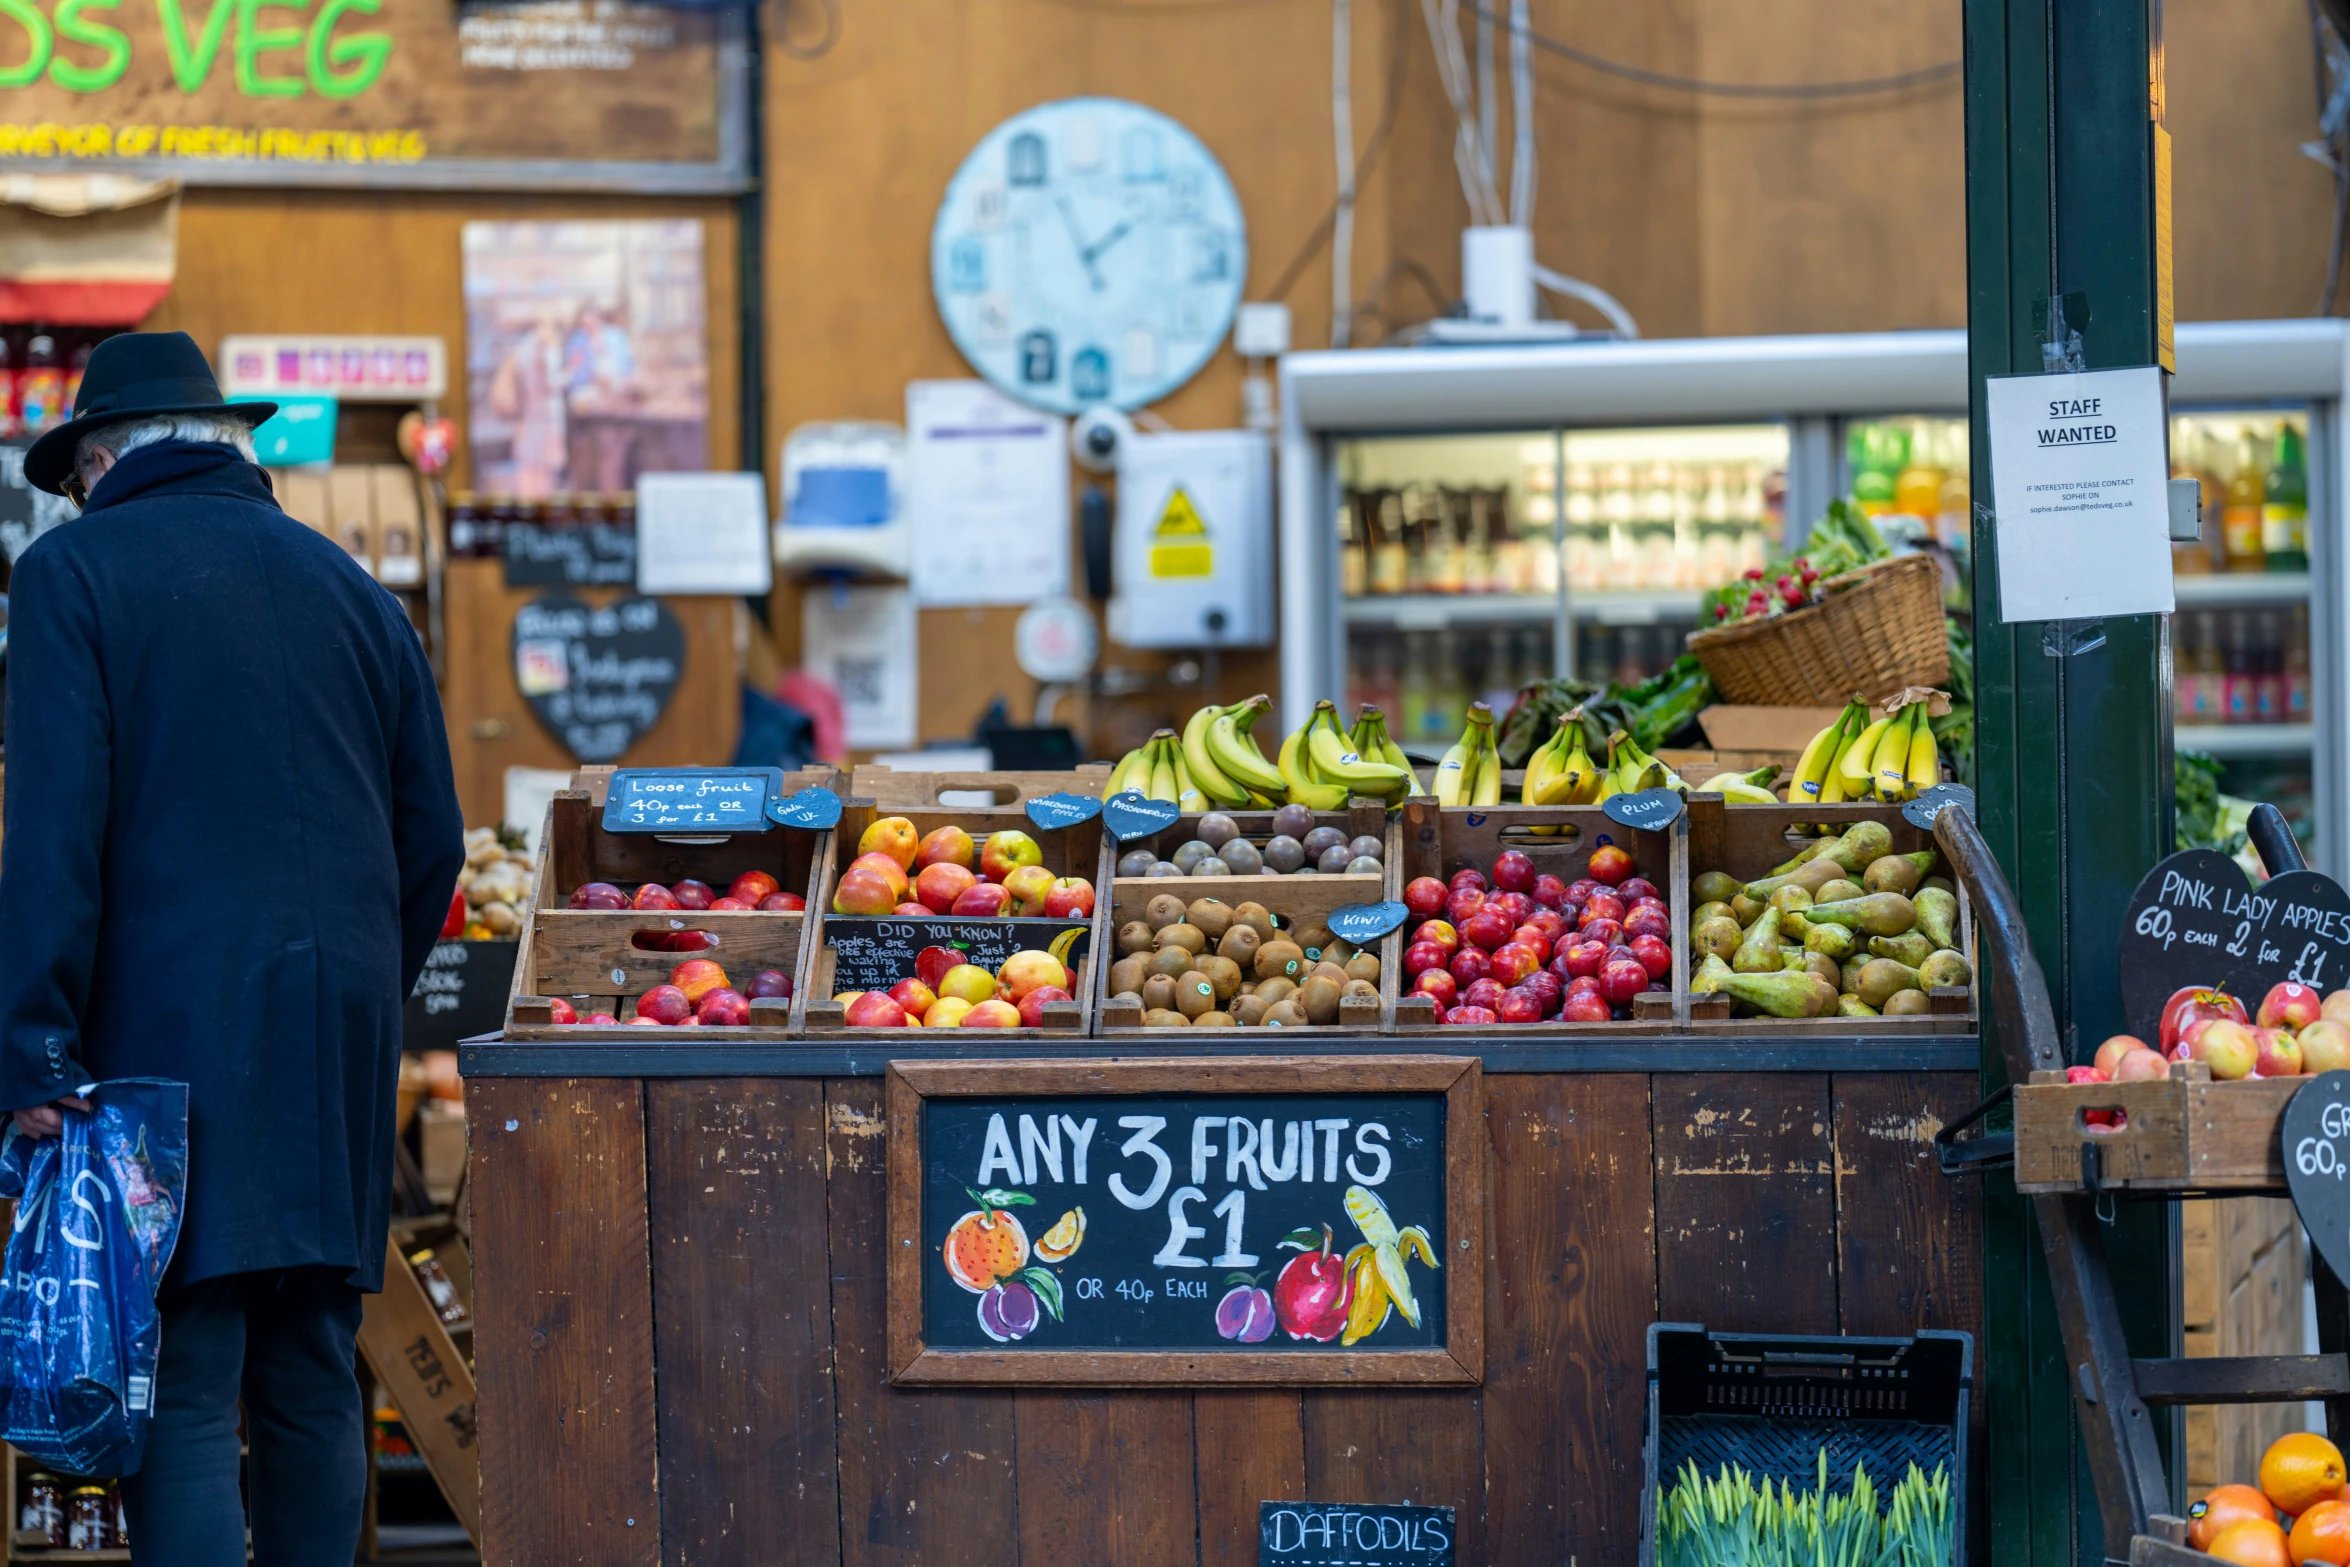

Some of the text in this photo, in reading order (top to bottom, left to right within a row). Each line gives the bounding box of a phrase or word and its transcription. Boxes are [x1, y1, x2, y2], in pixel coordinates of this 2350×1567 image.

[156, 0, 394, 99] VEG
[2049, 398, 2101, 416] STAFF
[2038, 424, 2117, 444] WANTED
[2034, 482, 2075, 491] INTERESTED
[2076, 481, 2100, 489] PLEASE
[2101, 478, 2134, 487] CONTACT
[2030, 500, 2133, 514] sophie.dawson@tedsveg.co.uk
[632, 780, 753, 797] Loose fruit
[629, 799, 670, 812] 40p
[720, 801, 743, 809] OR
[1112, 799, 1175, 820] PASSIONFRUIT
[1621, 799, 1664, 816] PLUM
[631, 812, 719, 824] 3 for £1
[2159, 870, 2350, 945] PINK LADY APPLES
[877, 922, 915, 938] DID
[924, 924, 953, 939] YOU
[828, 936, 909, 949] Apples are
[976, 944, 1005, 955] Just
[2135, 906, 2177, 951] 60p
[2184, 930, 2218, 947] EACH
[2226, 920, 2251, 957] 2
[2288, 941, 2328, 989] £1
[837, 947, 861, 956] ORE
[836, 968, 854, 976] ou
[860, 968, 879, 978] up
[977, 1112, 1392, 1209] ANY 3 FRUITS
[2295, 1137, 2347, 1181] 60p
[1153, 1186, 1260, 1267] £1
[1076, 1277, 1208, 1303] OR 40p EACH
[1269, 1510, 1449, 1552] DAFFODILS
